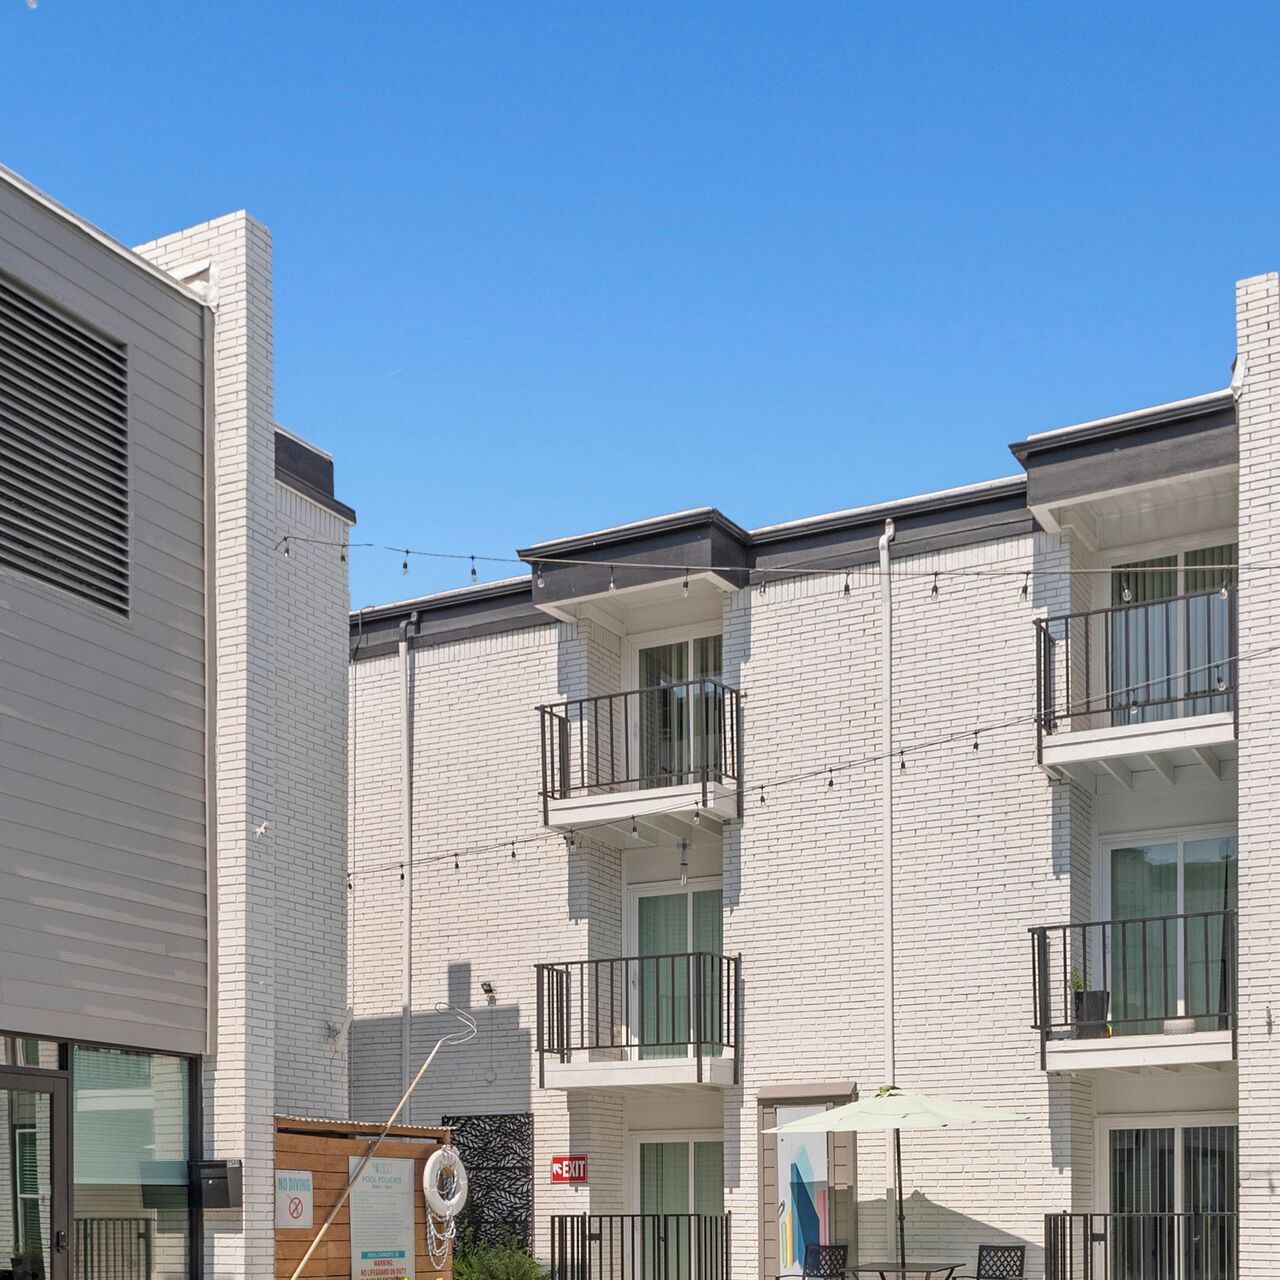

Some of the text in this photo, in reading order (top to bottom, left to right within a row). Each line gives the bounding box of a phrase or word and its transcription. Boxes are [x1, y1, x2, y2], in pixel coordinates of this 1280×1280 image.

[562, 1160, 585, 1177] EXIT
[278, 1177, 311, 1192] NO DIVING
[378, 1176, 402, 1184] POLICIES
[361, 1268, 367, 1276] NO
[368, 1268, 389, 1276] LIFEGUARD
[396, 1267, 406, 1275] DUTY
